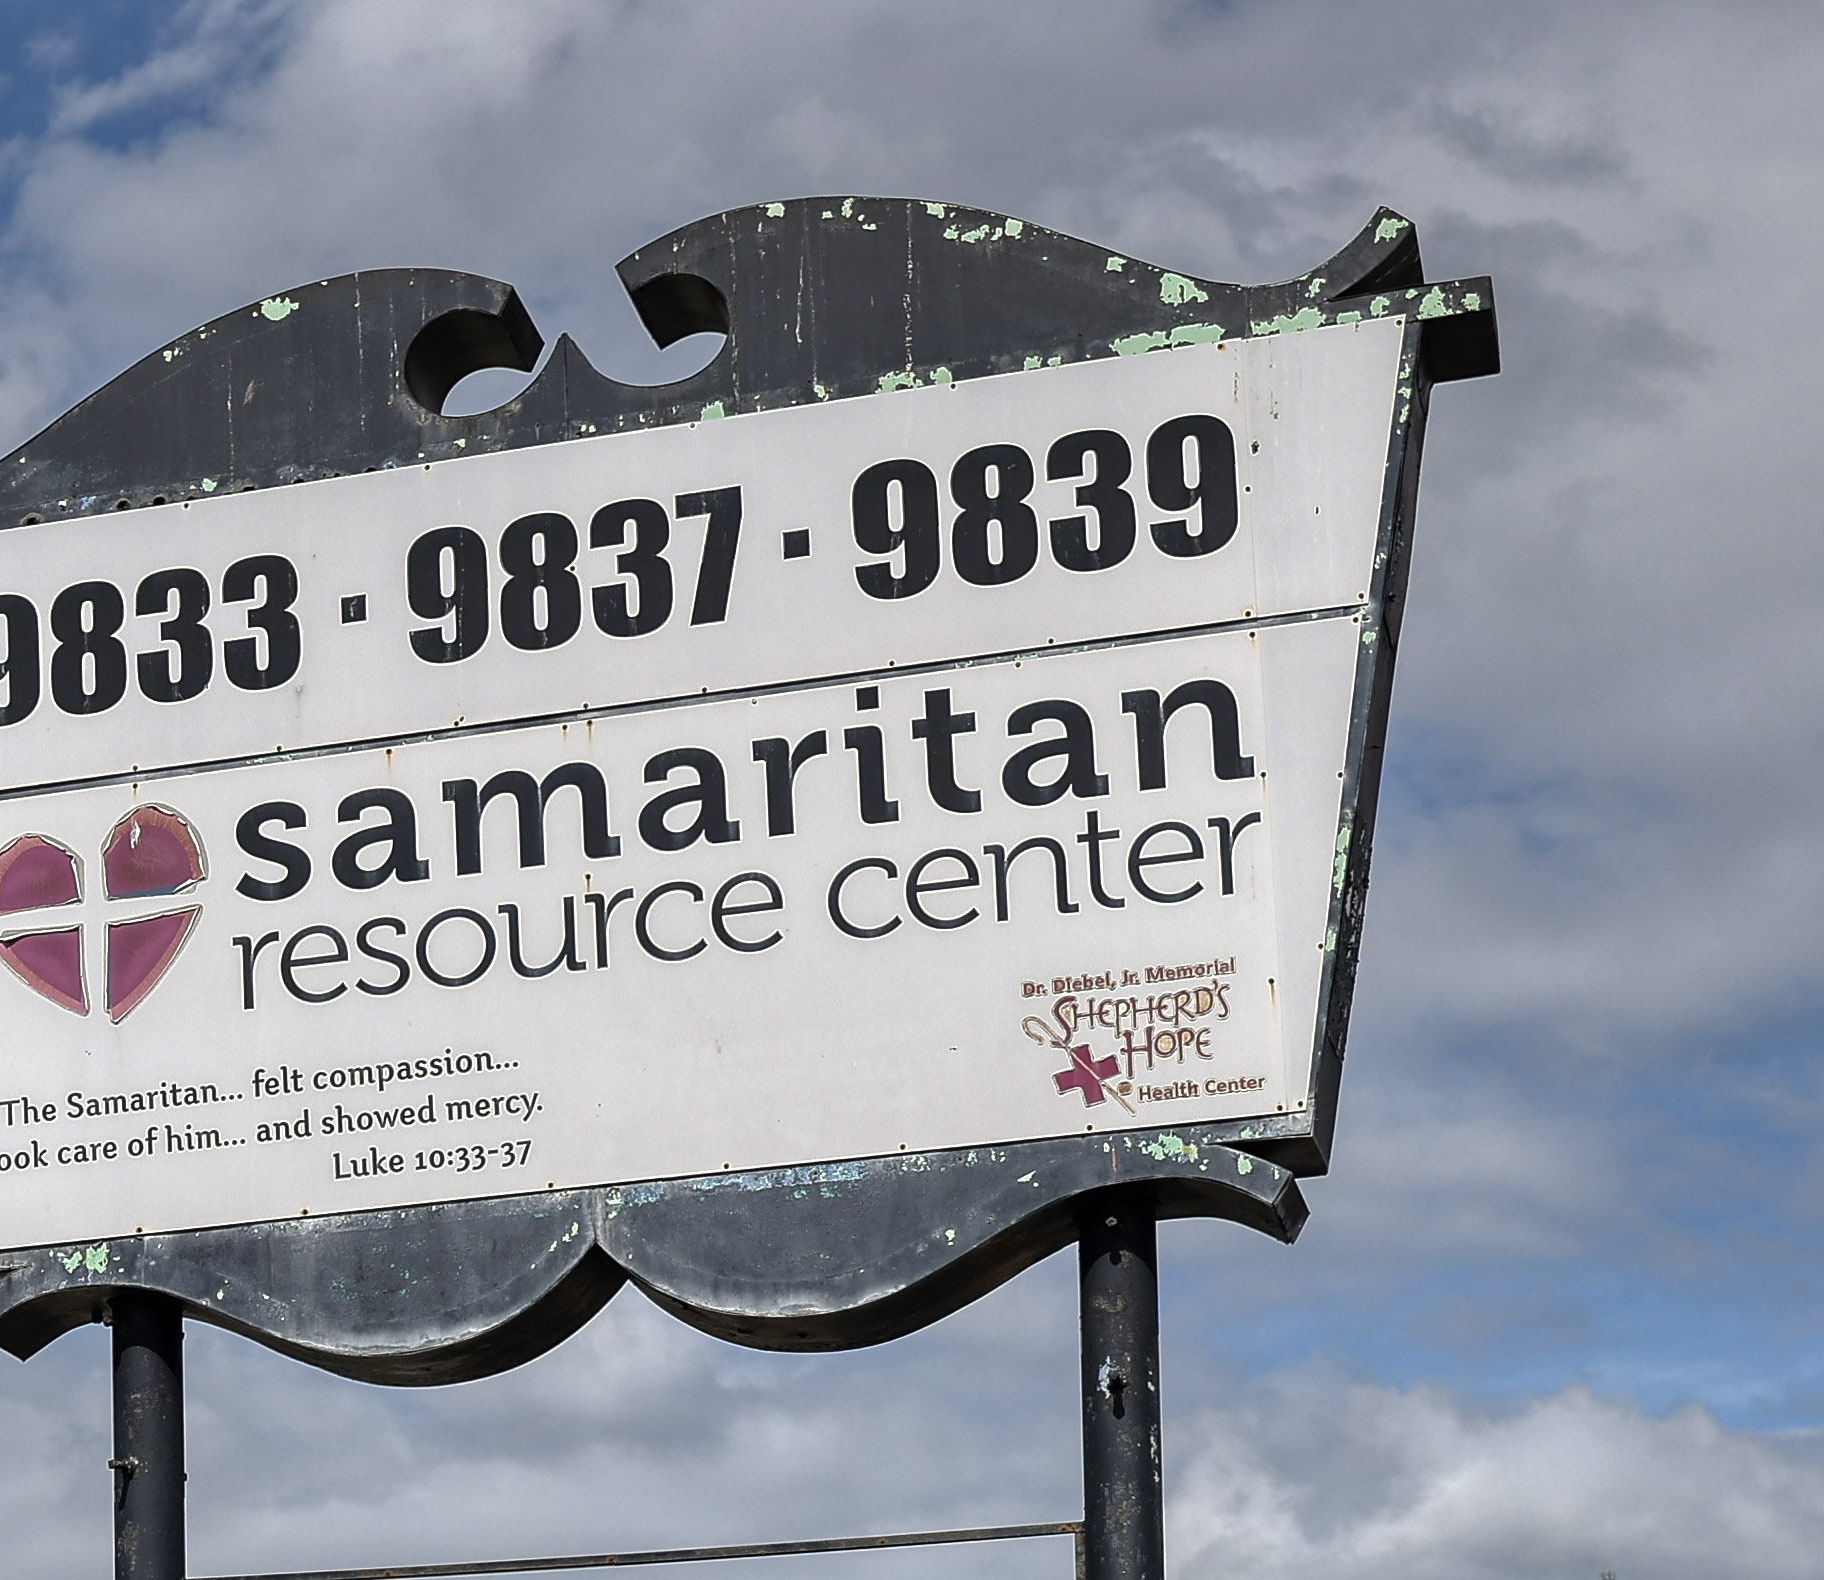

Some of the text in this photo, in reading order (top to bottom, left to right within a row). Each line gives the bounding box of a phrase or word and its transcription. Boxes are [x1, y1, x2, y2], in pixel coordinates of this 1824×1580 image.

[405, 485, 745, 665] 9837
[851, 413, 1239, 601] 9839
[235, 676, 1258, 903] samaritan
[233, 810, 1262, 1011] resource center
[1021, 956, 1237, 998] Dr. Diebel, Jr. Memorial
[0, 1048, 520, 1128] The Samaritan... felt compassion...
[1120, 1025, 1214, 1079] HOPE
[1138, 1075, 1266, 1102] Health Center
[57, 1142, 118, 1165] care
[127, 1126, 159, 1157] of
[165, 1124, 246, 1153] him...
[256, 1108, 313, 1143] and
[321, 1093, 437, 1135] showed
[445, 1090, 544, 1125] mercy.
[332, 1140, 533, 1180] Luke 10:33-37
